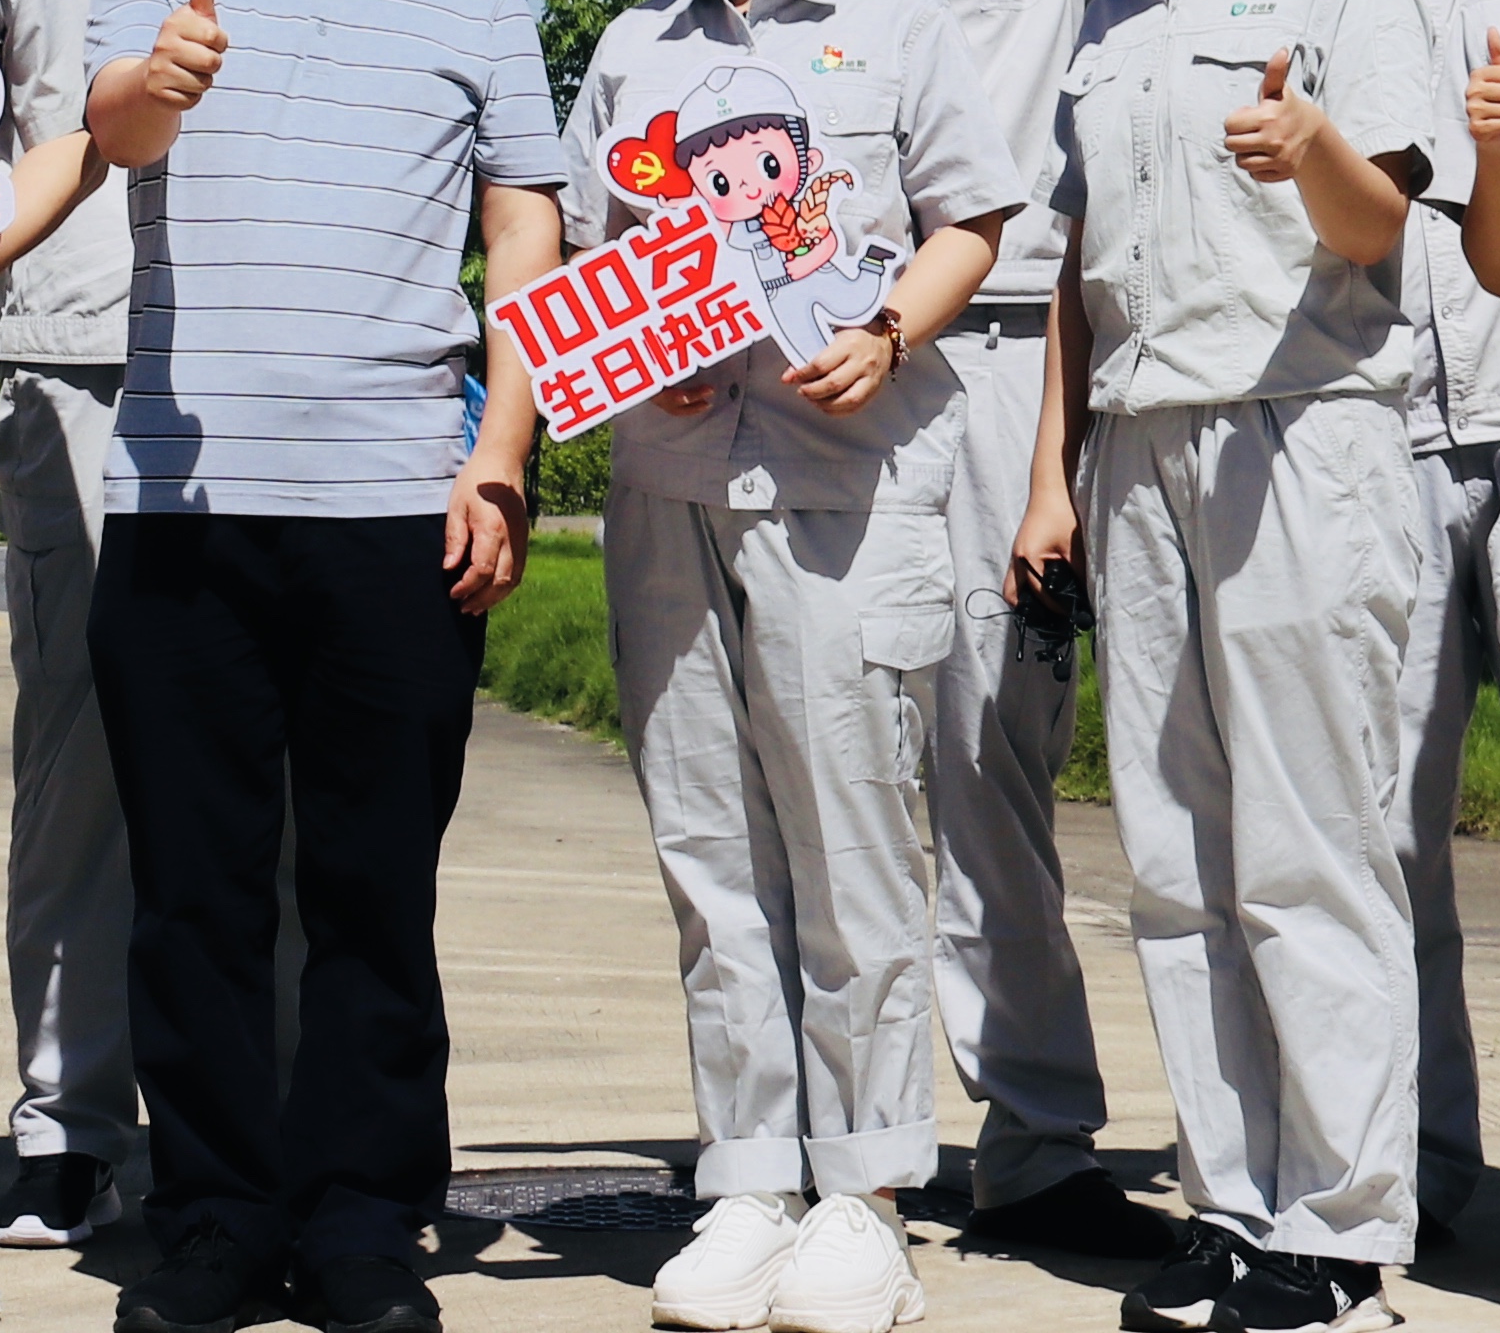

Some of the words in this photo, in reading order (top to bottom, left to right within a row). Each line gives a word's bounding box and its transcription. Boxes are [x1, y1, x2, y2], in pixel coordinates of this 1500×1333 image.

[495, 206, 717, 369] 100岁
[540, 281, 764, 433] 生日快乐
